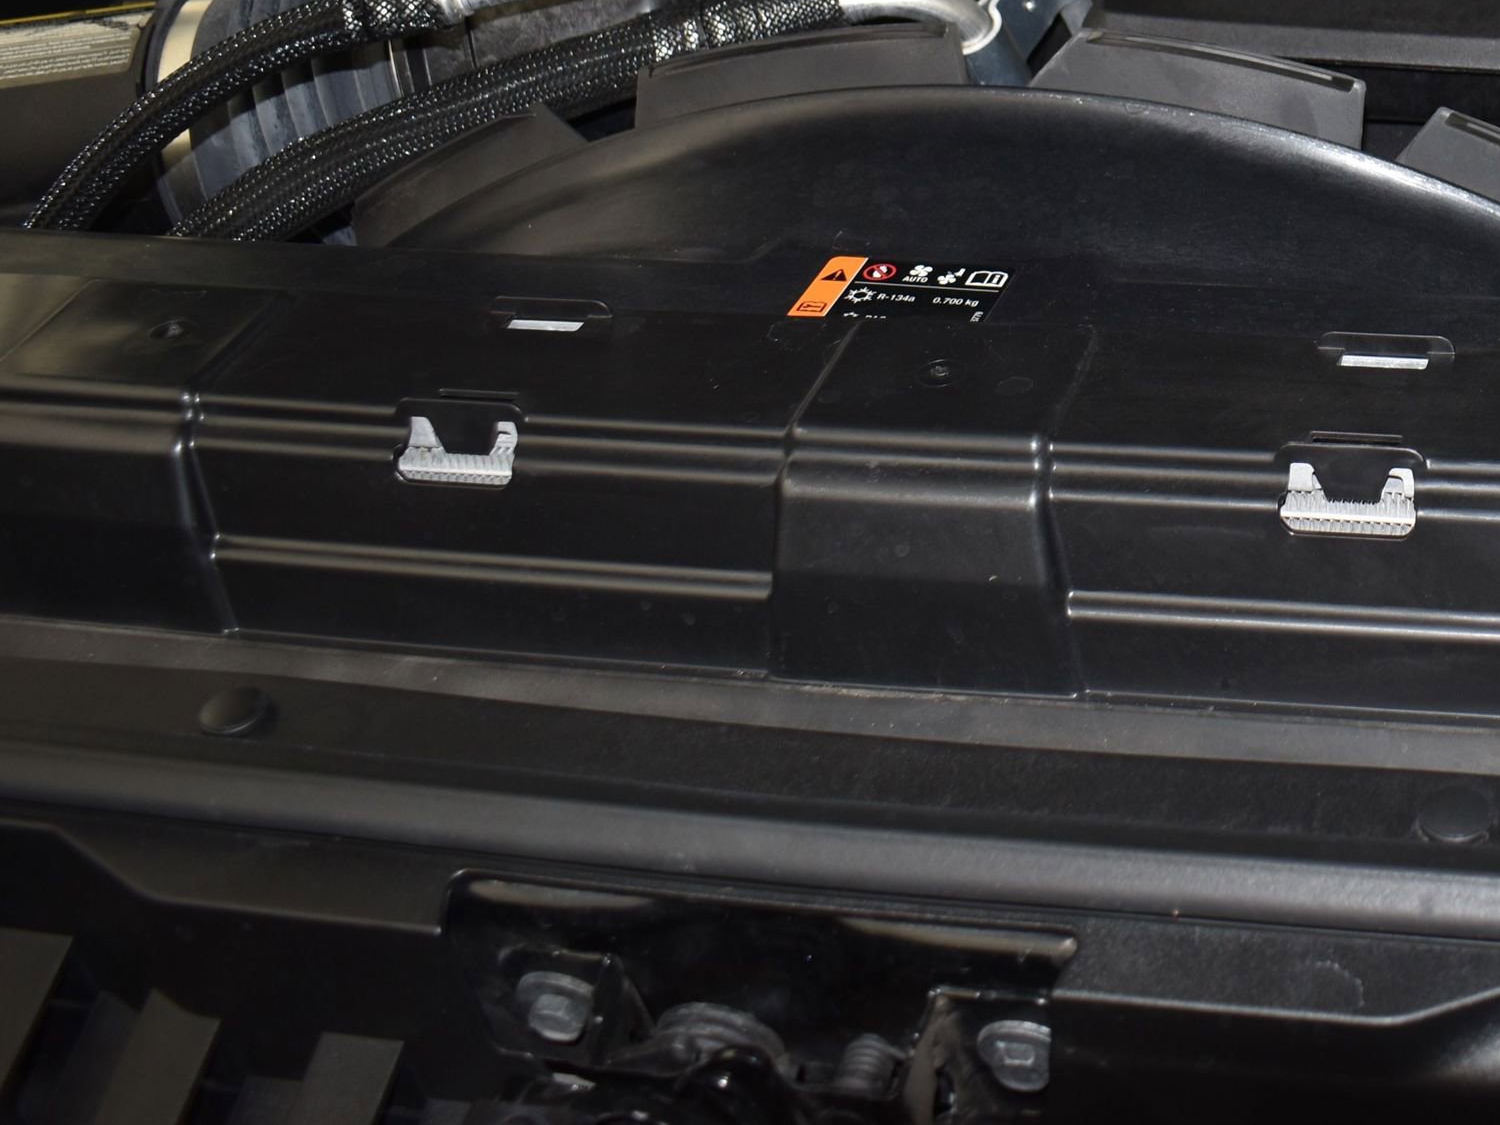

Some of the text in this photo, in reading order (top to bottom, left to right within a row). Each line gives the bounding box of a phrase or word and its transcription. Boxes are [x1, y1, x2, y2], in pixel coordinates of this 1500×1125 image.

[901, 275, 929, 283] AUTO
[876, 293, 980, 308] R-134a 0.700 kg
